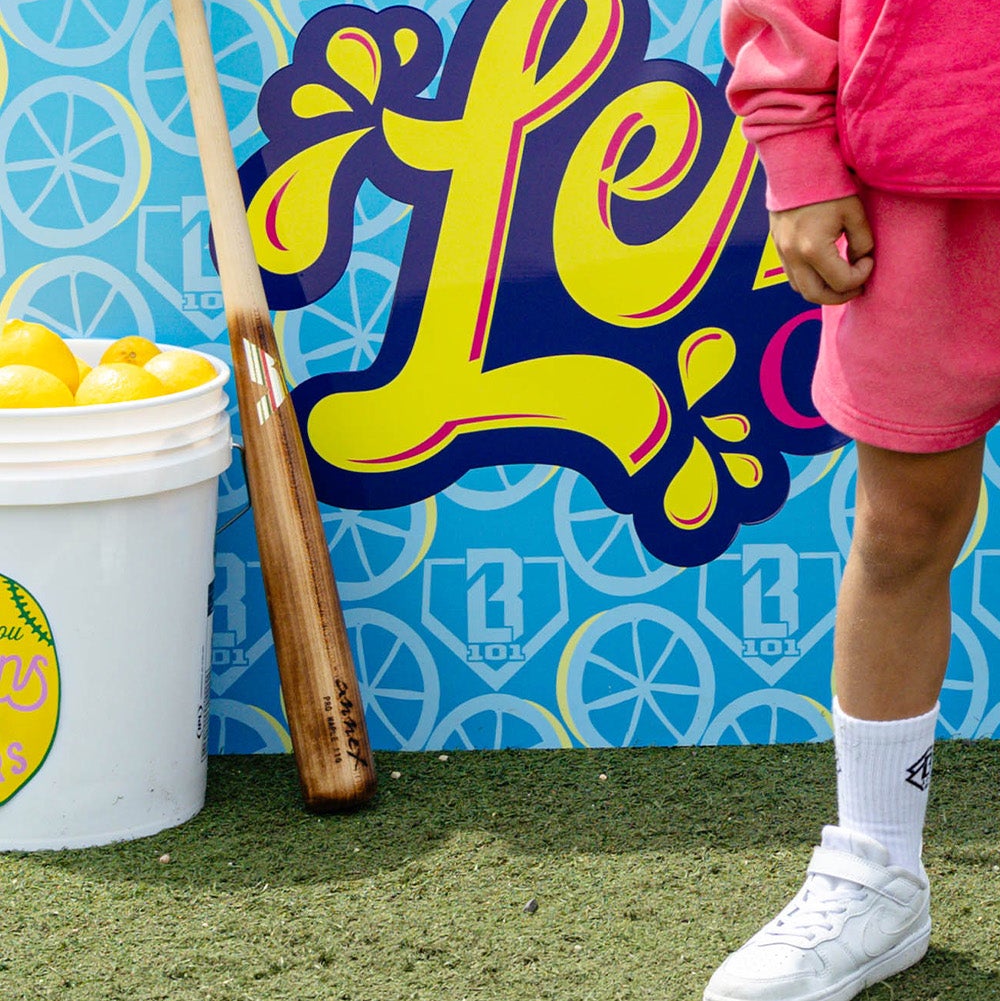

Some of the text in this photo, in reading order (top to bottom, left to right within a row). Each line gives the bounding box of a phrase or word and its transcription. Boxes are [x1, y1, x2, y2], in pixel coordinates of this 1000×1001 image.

[183, 292, 223, 310] 10
[467, 645, 525, 661] 101
[742, 639, 800, 656] 101
[212, 649, 248, 665] 01
